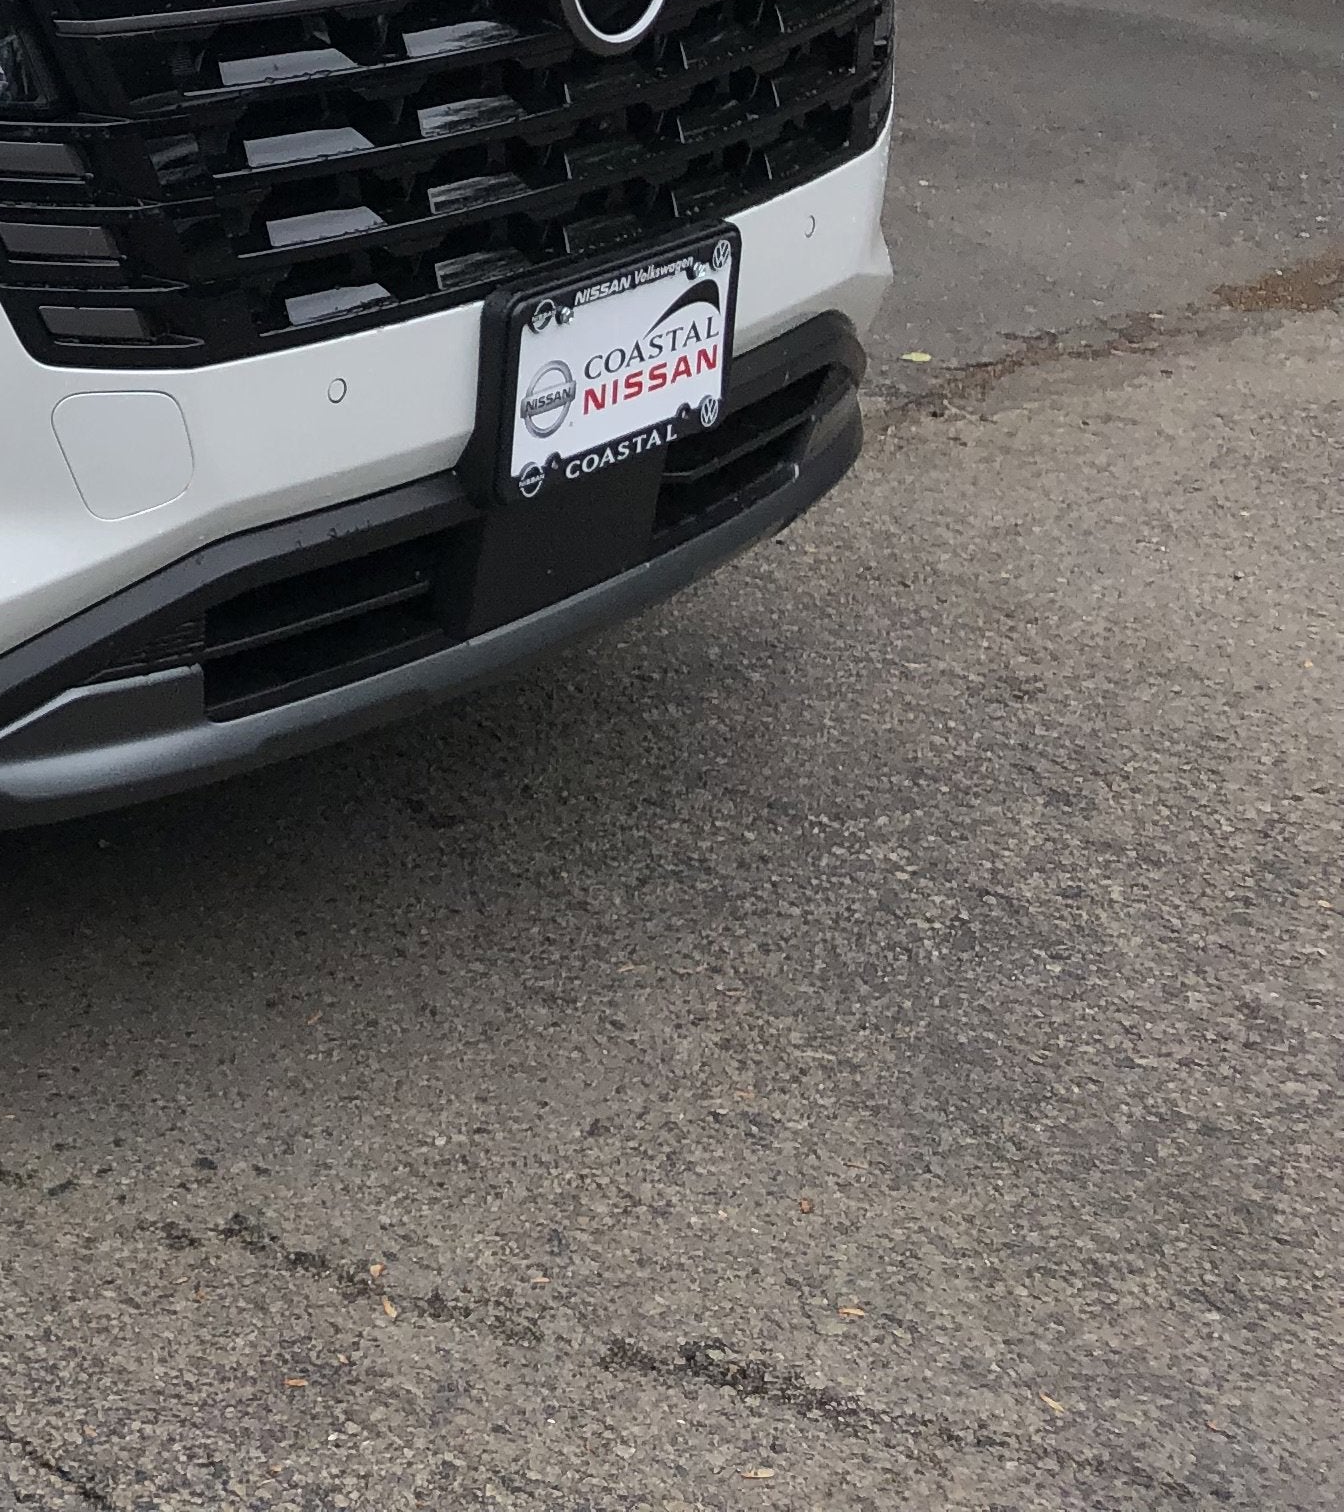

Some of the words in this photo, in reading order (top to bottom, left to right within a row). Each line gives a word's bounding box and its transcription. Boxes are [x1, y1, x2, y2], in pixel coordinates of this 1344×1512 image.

[574, 275, 631, 305] NISSAN
[634, 256, 694, 285] Volkswagen
[584, 316, 720, 380] COASTAL
[525, 387, 572, 412] NISSAN
[583, 344, 718, 415] NISSAN
[565, 424, 678, 479] COASTAL
